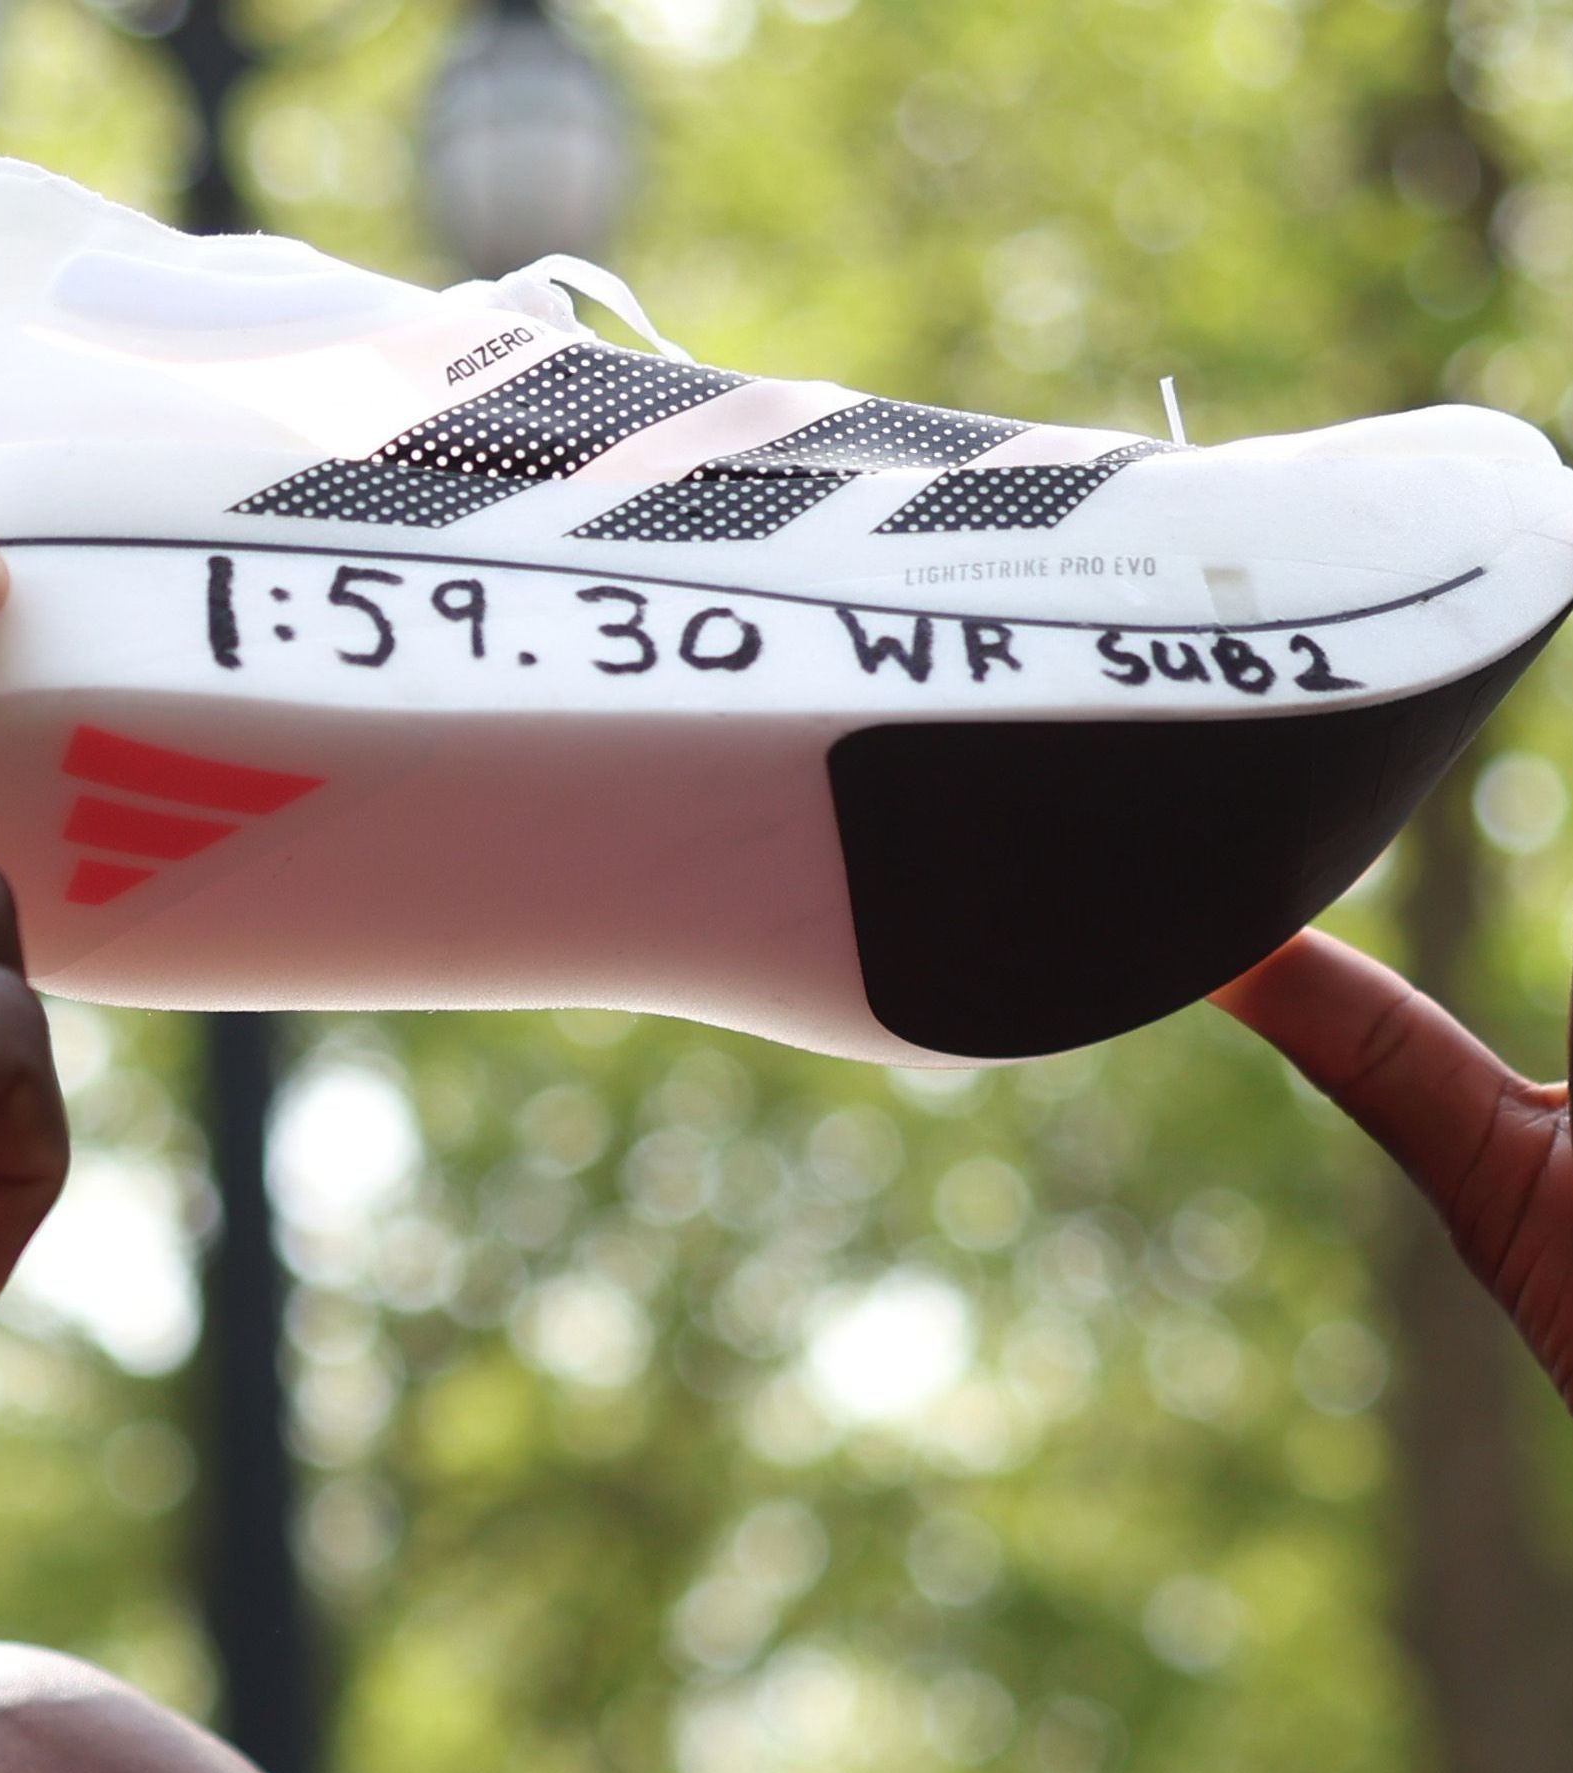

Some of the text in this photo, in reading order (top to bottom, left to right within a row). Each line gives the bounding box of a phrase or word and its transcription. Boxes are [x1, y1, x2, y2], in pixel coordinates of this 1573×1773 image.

[445, 326, 534, 387] ADIZERO
[905, 556, 1156, 586] LIGHTSTRIKE PRO EVO
[208, 556, 763, 674] 1:59.30
[836, 606, 1022, 682] WR
